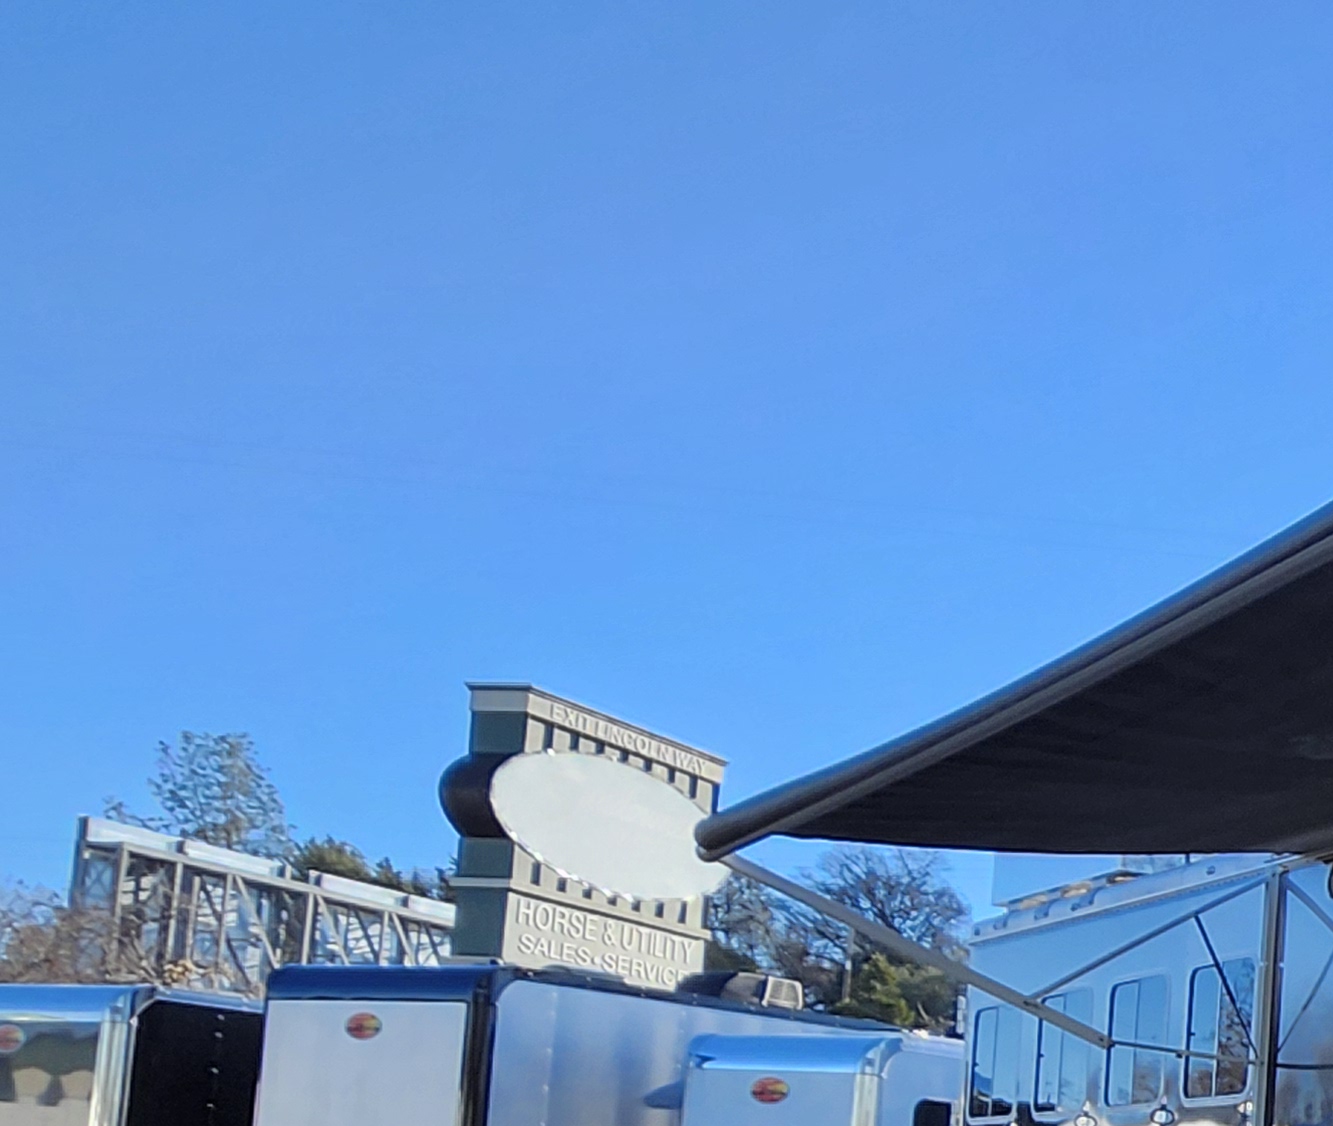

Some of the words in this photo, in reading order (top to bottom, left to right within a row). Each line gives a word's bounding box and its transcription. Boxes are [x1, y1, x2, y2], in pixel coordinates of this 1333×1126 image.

[551, 703, 587, 731] EXIT
[672, 751, 706, 775] WAY
[516, 898, 599, 942] HORSE
[602, 921, 616, 948] &
[620, 924, 696, 964] UTILITY
[518, 933, 591, 967] SALES
